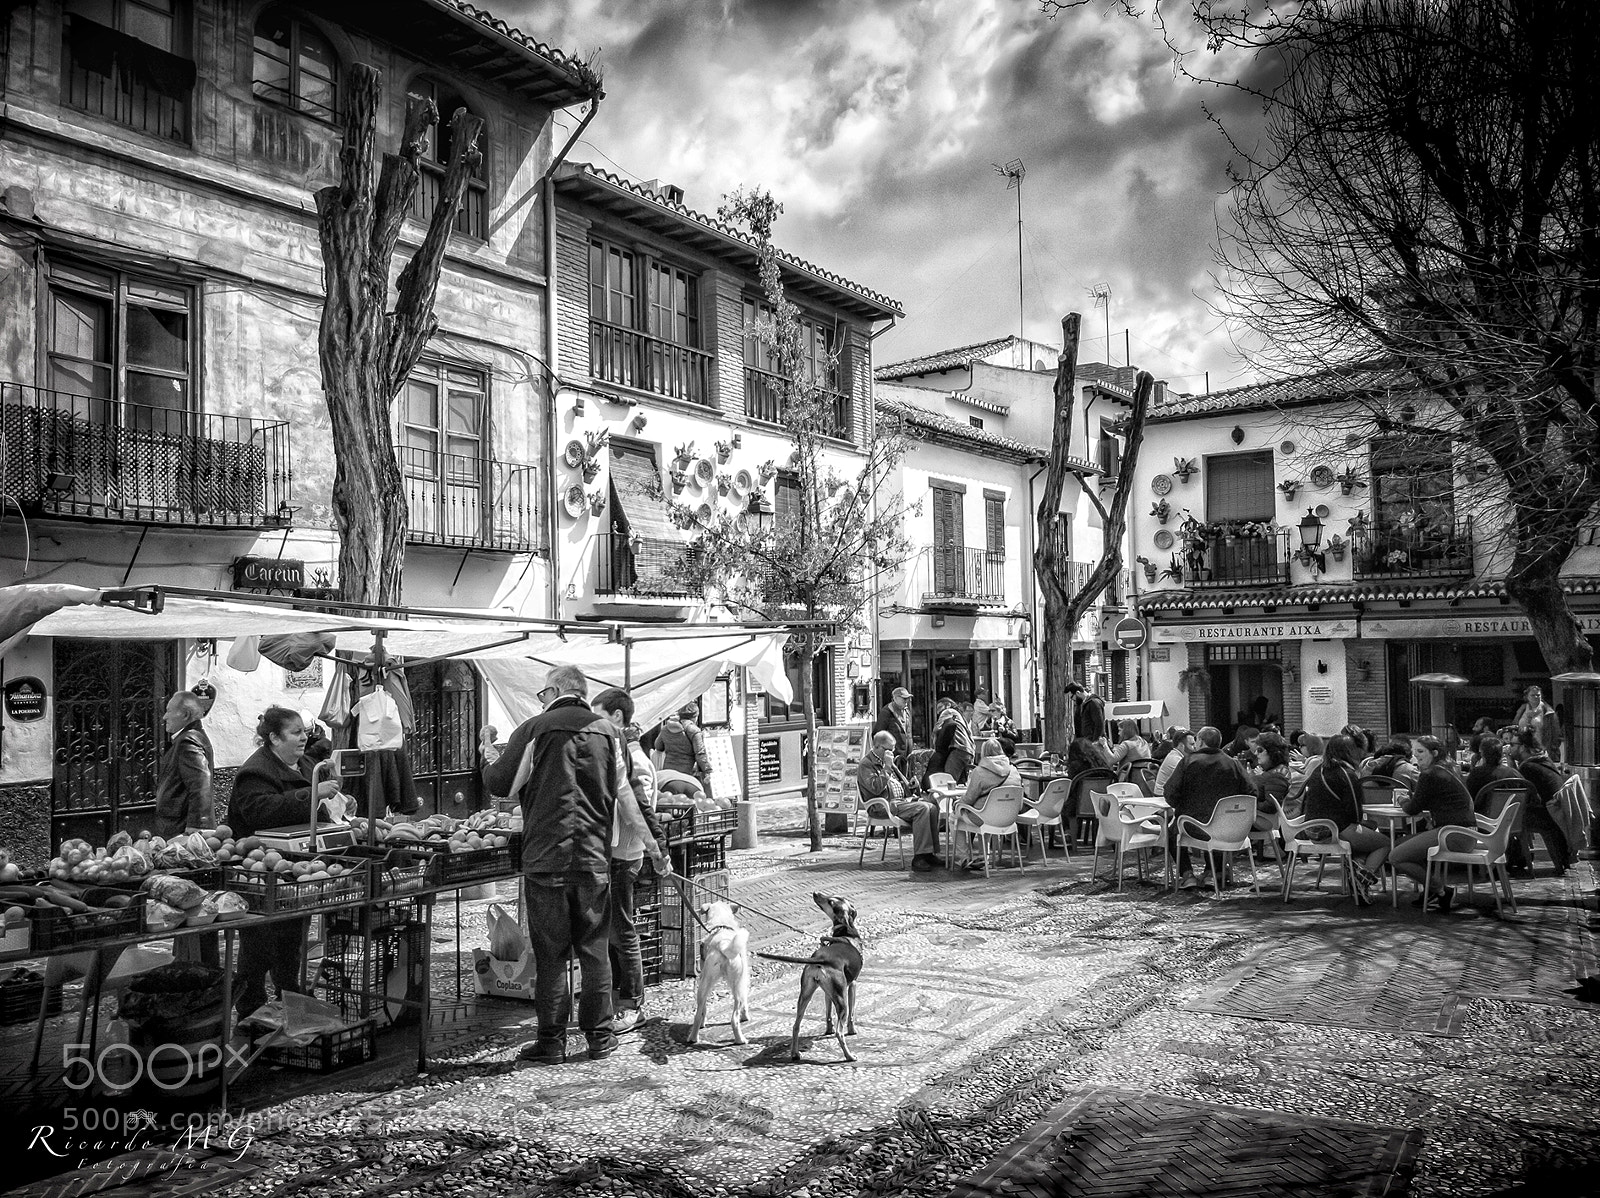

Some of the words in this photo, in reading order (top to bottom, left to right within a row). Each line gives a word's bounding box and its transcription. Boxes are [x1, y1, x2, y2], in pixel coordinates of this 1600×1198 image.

[1199, 627, 1284, 637] RESTAURANTE
[1289, 626, 1321, 635] AIXA
[1464, 622, 1530, 632] RESTAUR
[496, 979, 522, 992] Coplaca
